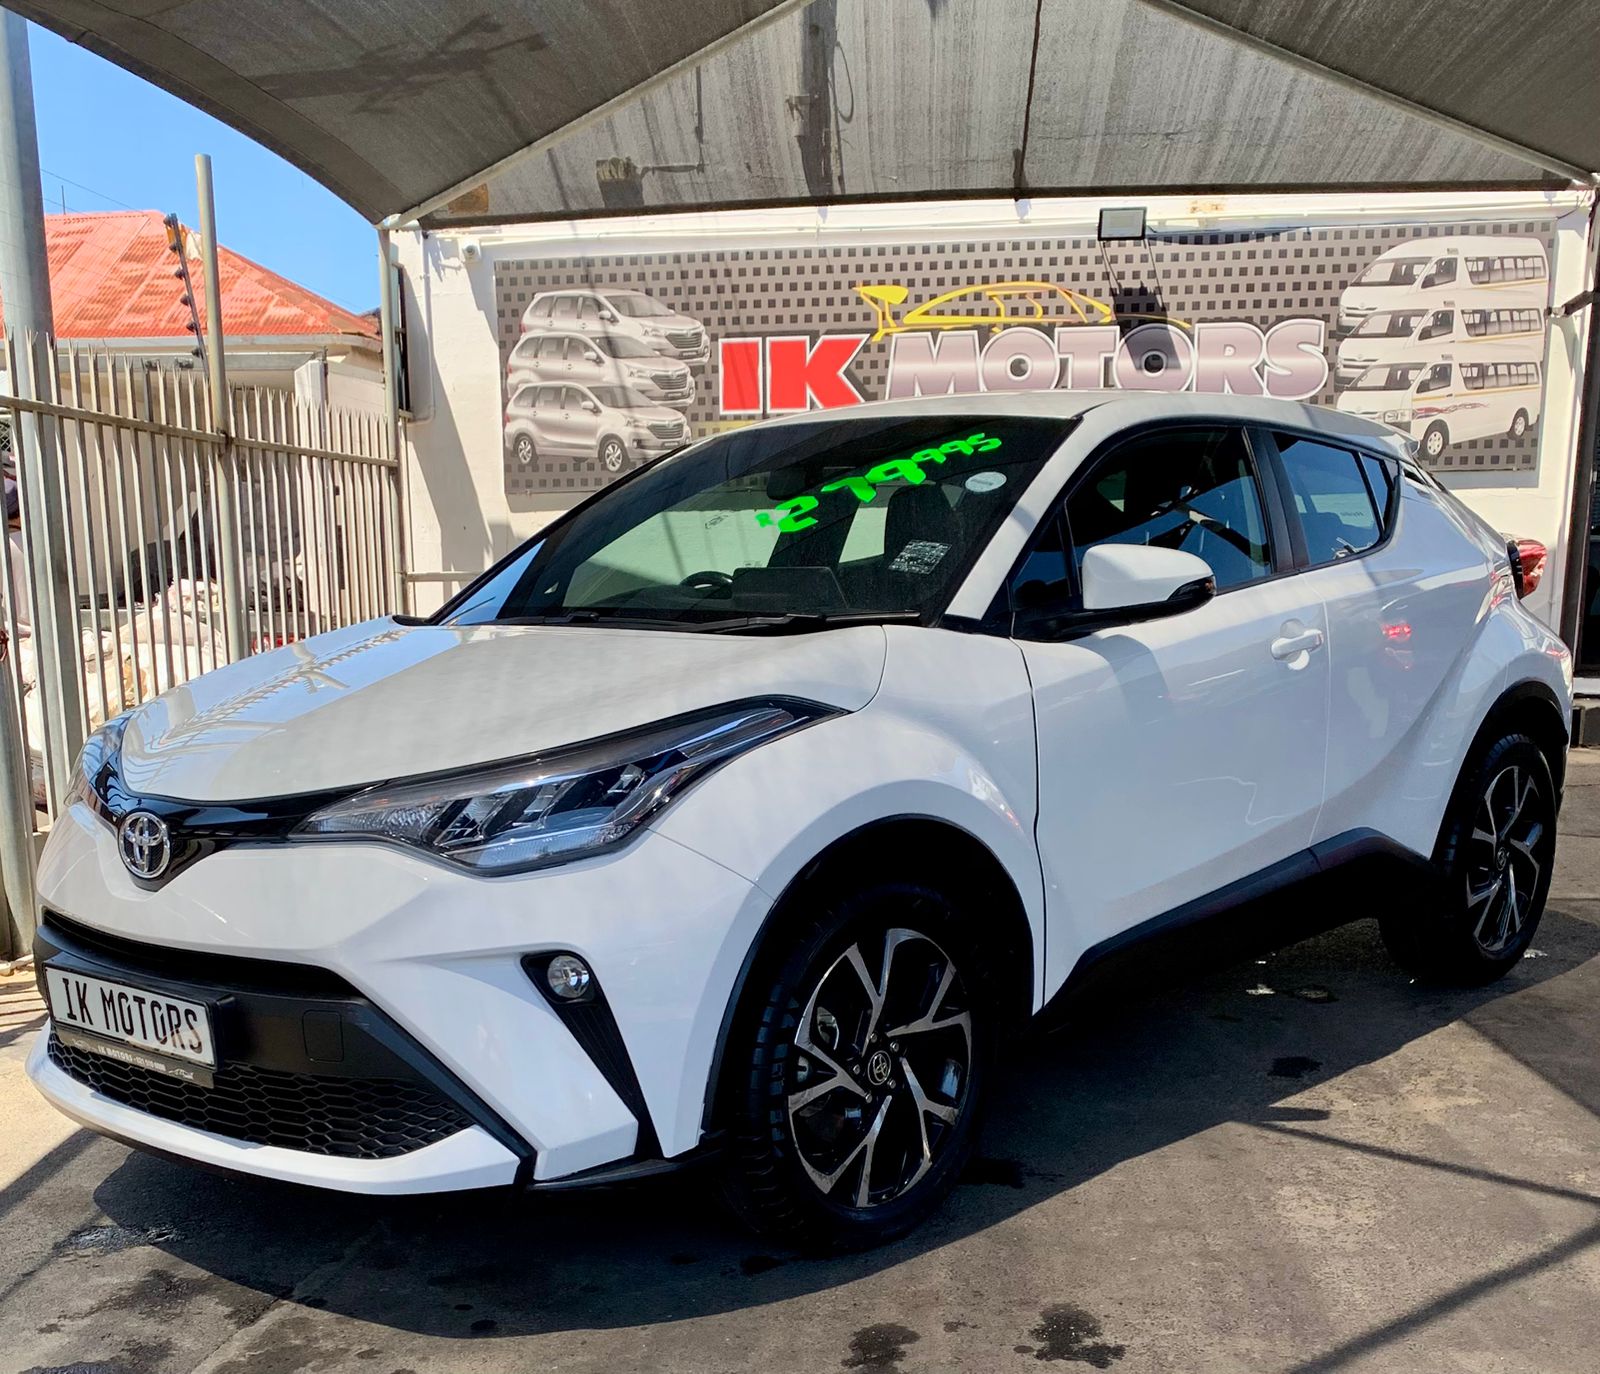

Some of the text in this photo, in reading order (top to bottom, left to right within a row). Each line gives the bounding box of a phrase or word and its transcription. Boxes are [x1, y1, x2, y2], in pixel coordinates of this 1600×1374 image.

[718, 318, 1329, 415] IK MOTORS
[62, 977, 203, 1054] IK MOTORS
